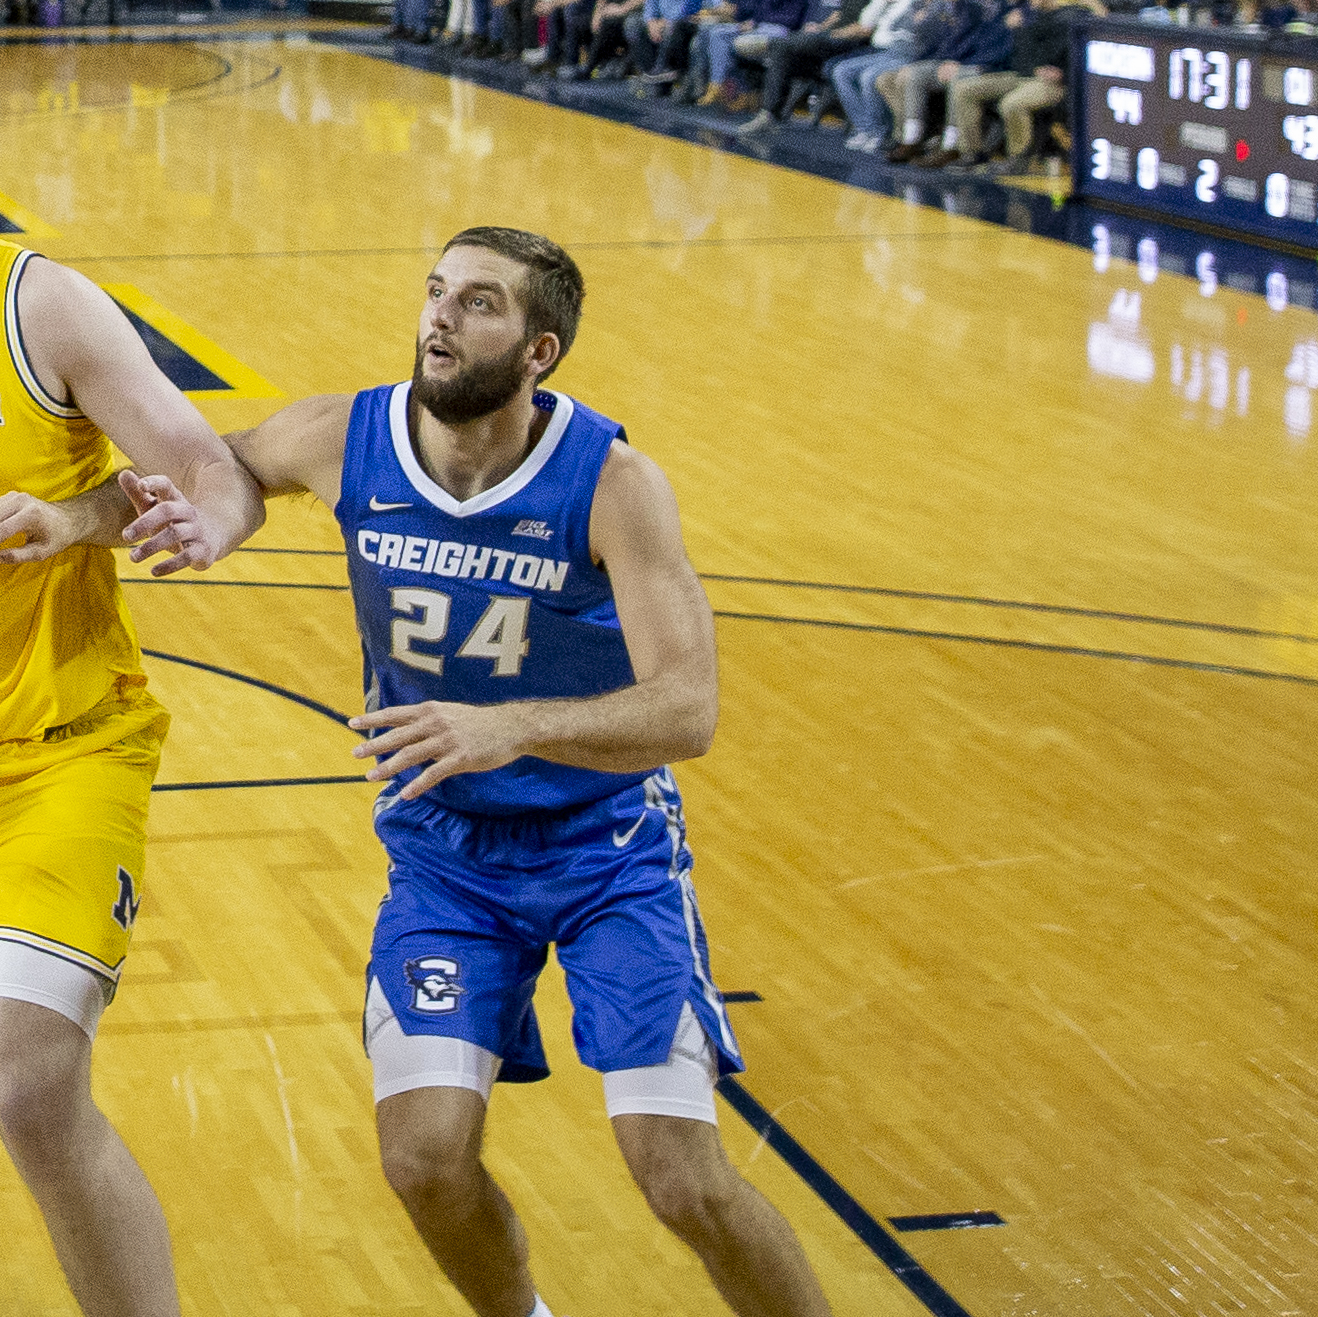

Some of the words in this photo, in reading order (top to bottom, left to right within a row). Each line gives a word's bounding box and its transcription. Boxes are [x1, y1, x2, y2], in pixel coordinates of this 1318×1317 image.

[1091, 138, 1111, 180] 3
[1195, 159, 1219, 202] 2
[357, 528, 572, 593] CREIGHTON
[388, 586, 531, 678] 24
